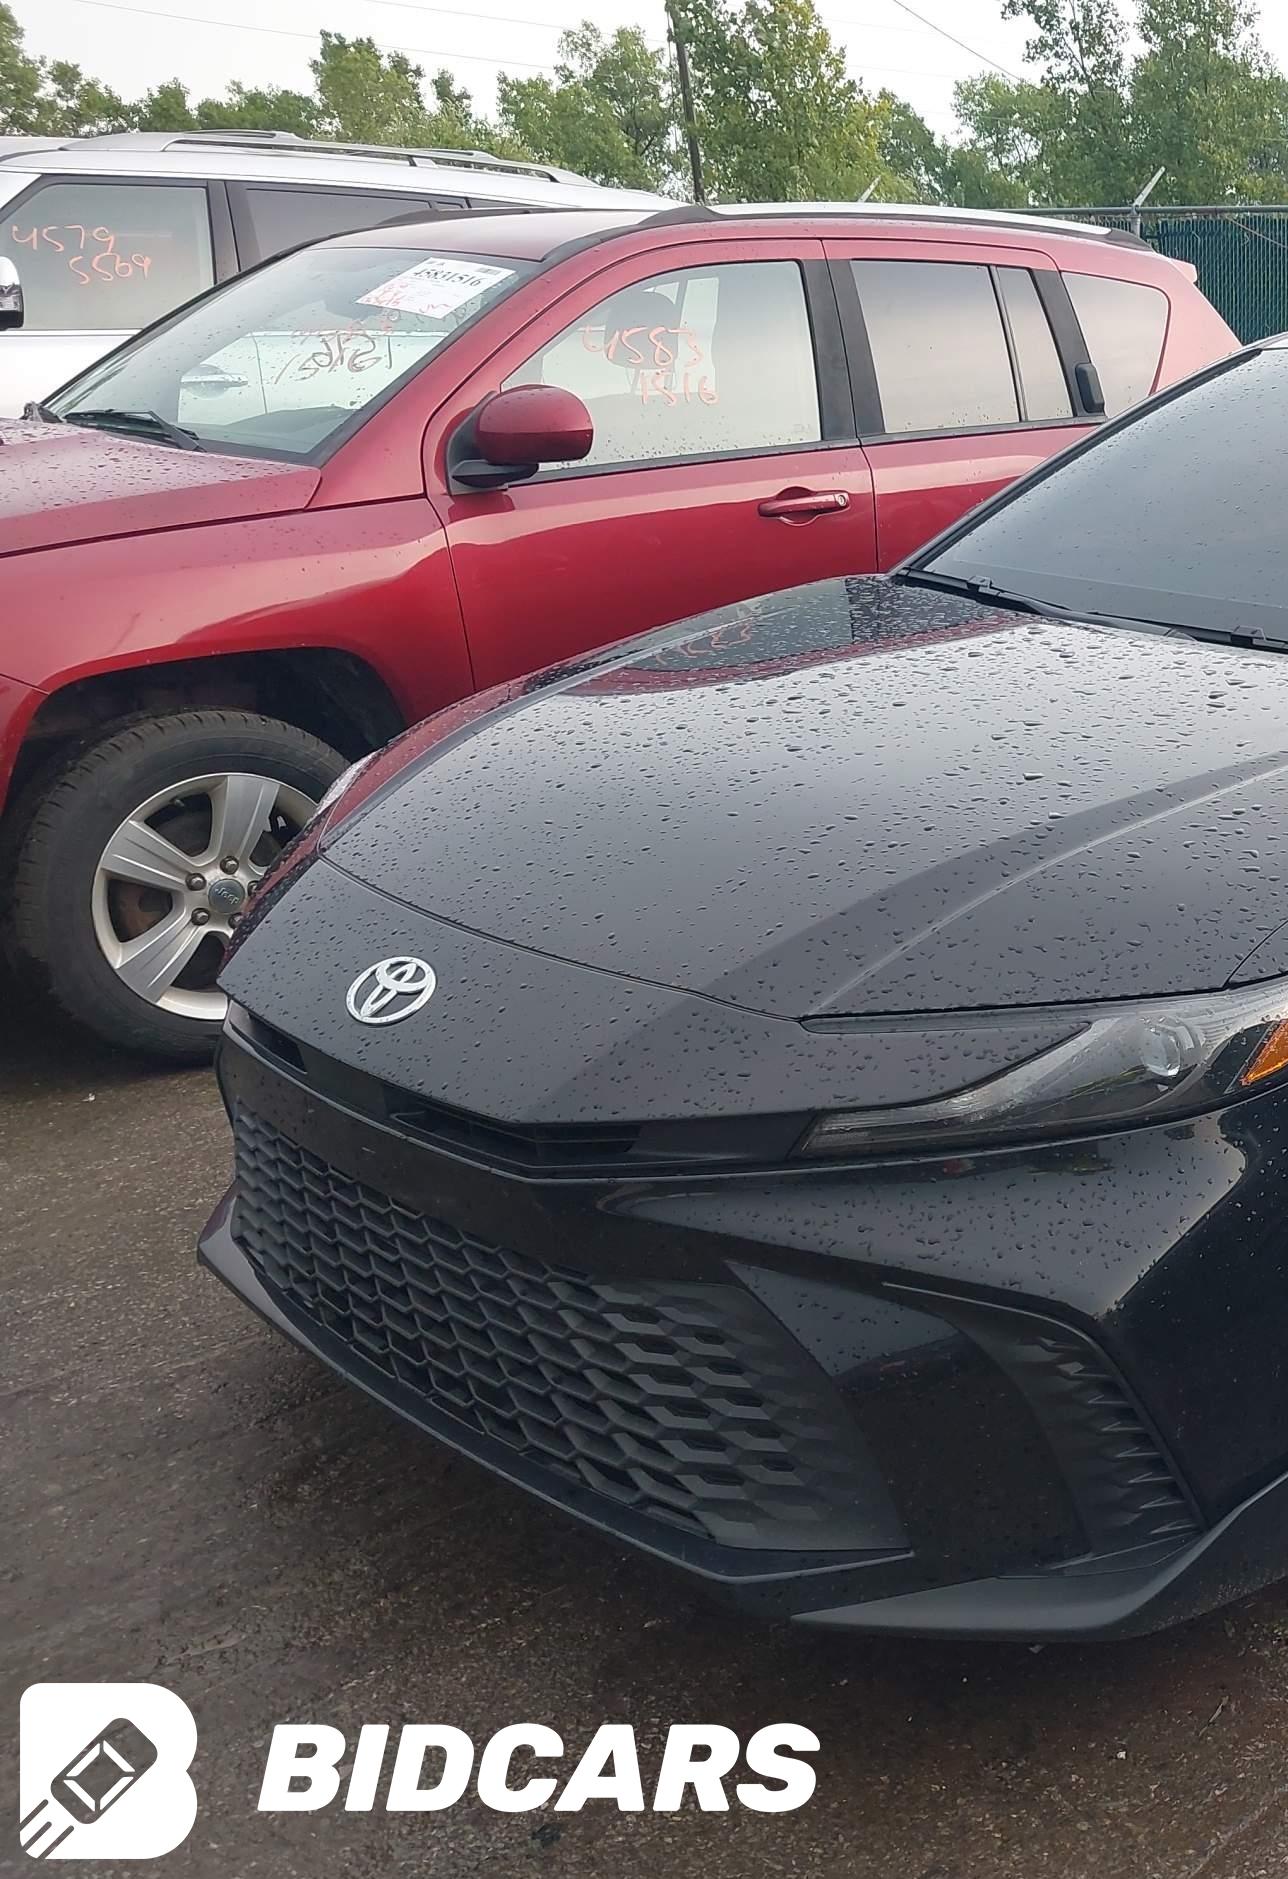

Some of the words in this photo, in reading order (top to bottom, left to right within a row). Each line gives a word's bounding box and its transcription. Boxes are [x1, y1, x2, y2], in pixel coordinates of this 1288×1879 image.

[12, 224, 115, 254] 4579
[68, 252, 151, 285] 5569
[582, 326, 705, 368] 4583
[640, 368, 720, 407] 1516
[214, 887, 240, 905] Jeep
